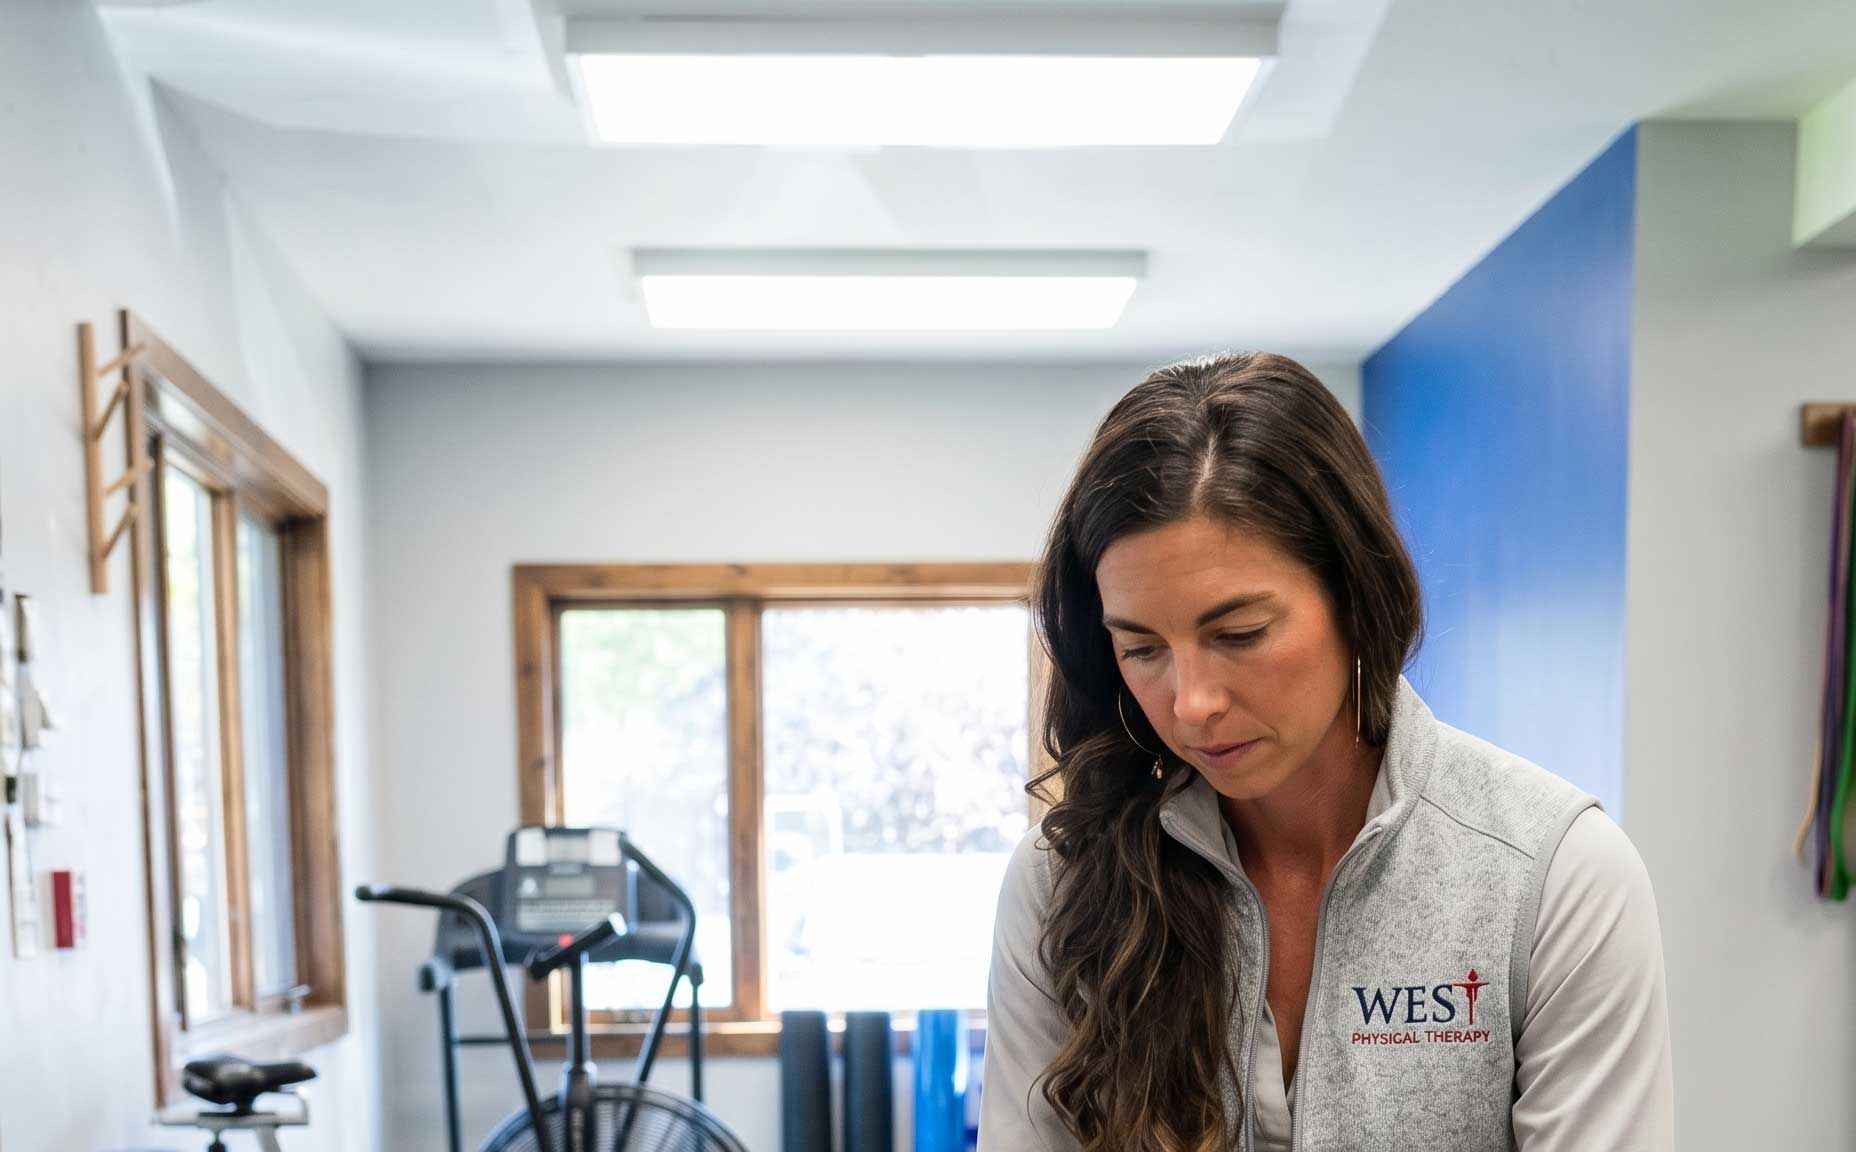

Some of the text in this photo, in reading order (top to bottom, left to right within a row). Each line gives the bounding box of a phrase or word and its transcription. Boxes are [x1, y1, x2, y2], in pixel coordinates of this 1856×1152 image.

[1352, 969, 1489, 1025] WEST
[1352, 1031, 1490, 1045] PHYSICAL THERAPY
